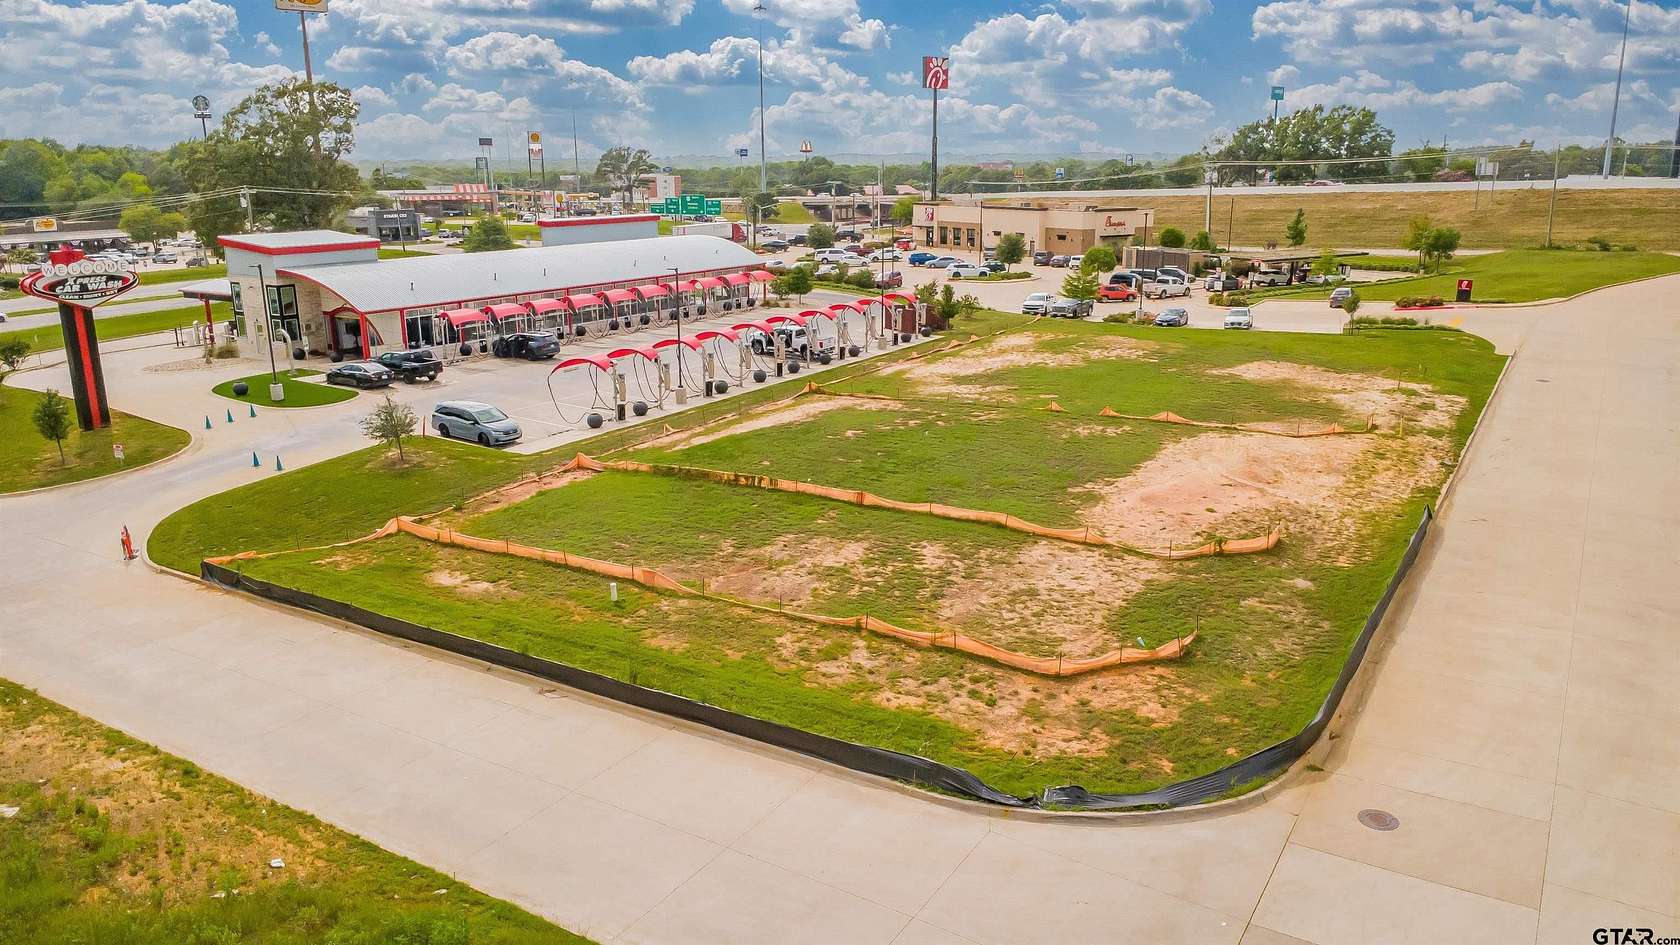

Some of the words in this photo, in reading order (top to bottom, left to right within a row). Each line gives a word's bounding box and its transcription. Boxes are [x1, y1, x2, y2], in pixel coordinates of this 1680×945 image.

[42, 261, 128, 276] WELCOME
[55, 284, 81, 294] CAR
[87, 280, 123, 291] WASH
